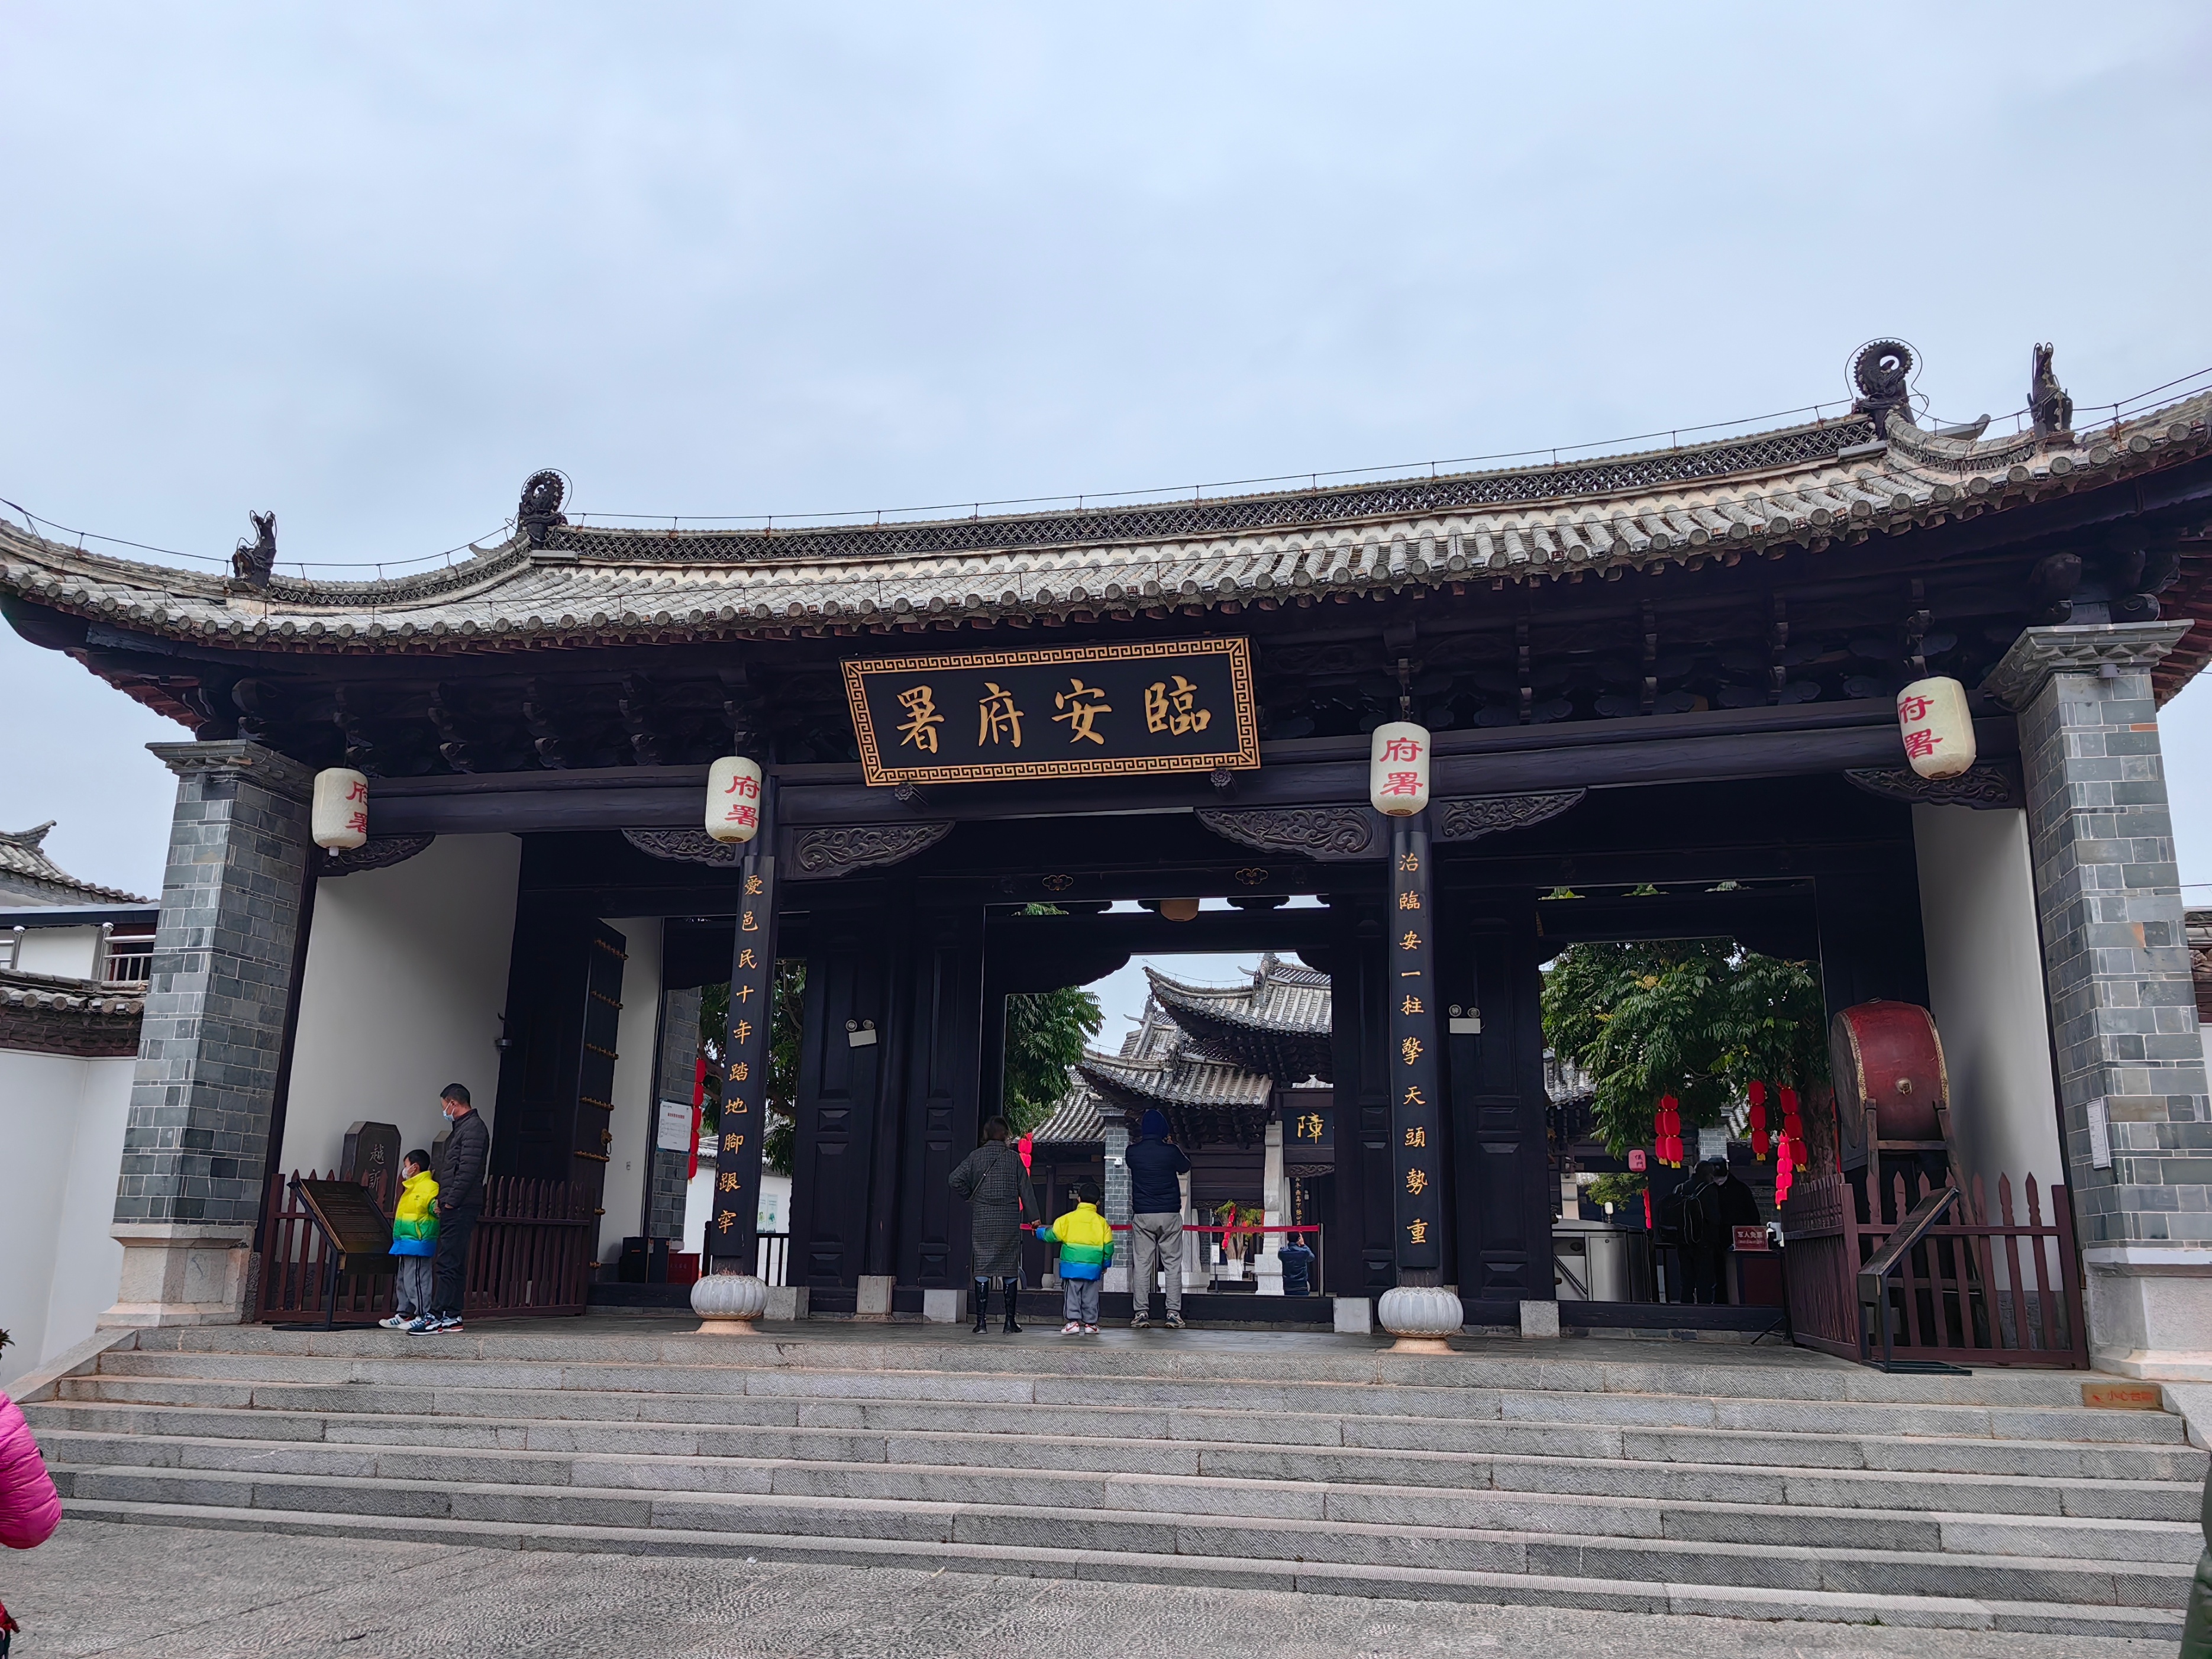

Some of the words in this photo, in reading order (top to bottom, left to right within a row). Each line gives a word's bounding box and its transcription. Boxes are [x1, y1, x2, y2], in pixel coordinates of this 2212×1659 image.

[896, 675, 1212, 754] 臨安府署
[1898, 695, 1943, 760] 府署
[1379, 737, 1423, 796] 府署
[725, 775, 760, 828] 府署
[1399, 853, 1428, 1244] 治臨安一柱擎天頭勢重
[1296, 1112, 1325, 1144] 障
